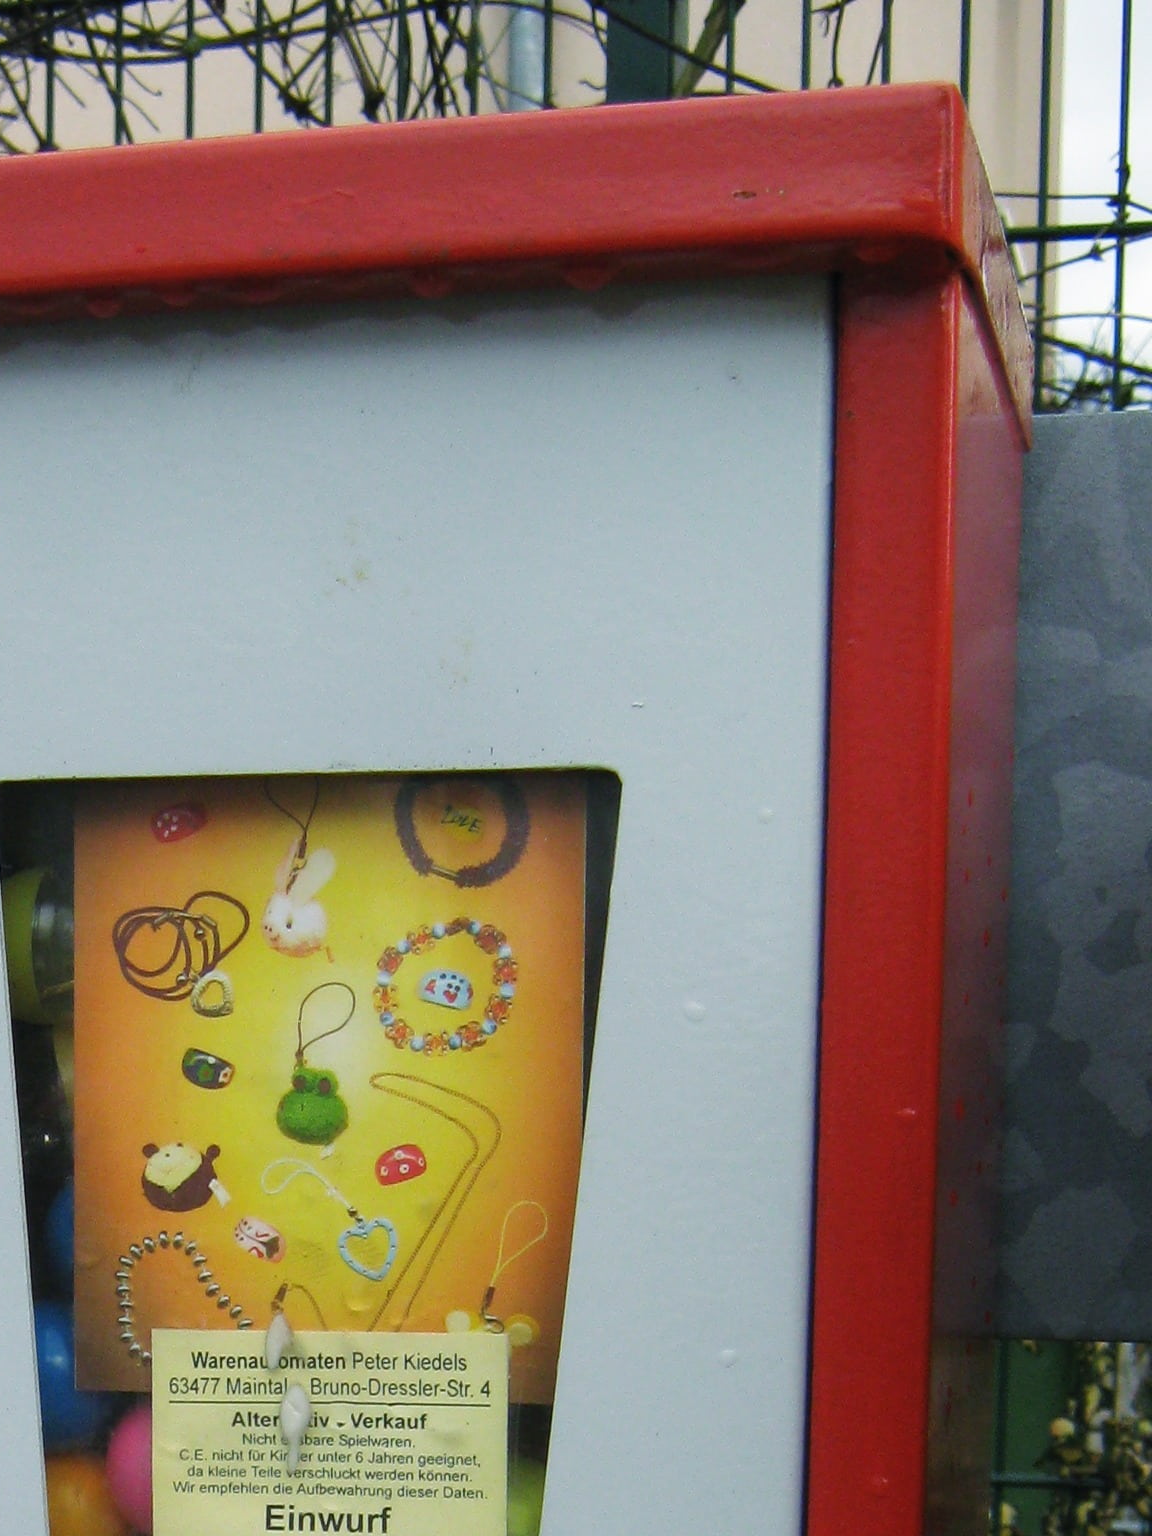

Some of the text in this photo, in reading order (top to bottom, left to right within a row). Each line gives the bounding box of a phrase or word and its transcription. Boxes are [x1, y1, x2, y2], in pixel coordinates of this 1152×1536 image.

[191, 1351, 468, 1371] Warenauomaten Peter Kiedels
[169, 1377, 491, 1398] 63477 Maintal Bruno-Dressler-Str. 4
[232, 1411, 330, 1428] Altertiv
[350, 1412, 428, 1430] Verkauf
[242, 1432, 416, 1449] Nicht esbare Spielwaren.
[179, 1448, 481, 1469] C.E. nicht für Kiner unter 6 Jahren geeignet,
[187, 1464, 204, 1478] da
[207, 1465, 247, 1479] kleine
[251, 1465, 282, 1479] Teile
[364, 1469, 414, 1482] werden
[418, 1469, 473, 1483] können.
[173, 1481, 489, 1501] Wir empfehlen die Aufbewahrung dieser Daten.
[265, 1504, 392, 1534] Einwurf
